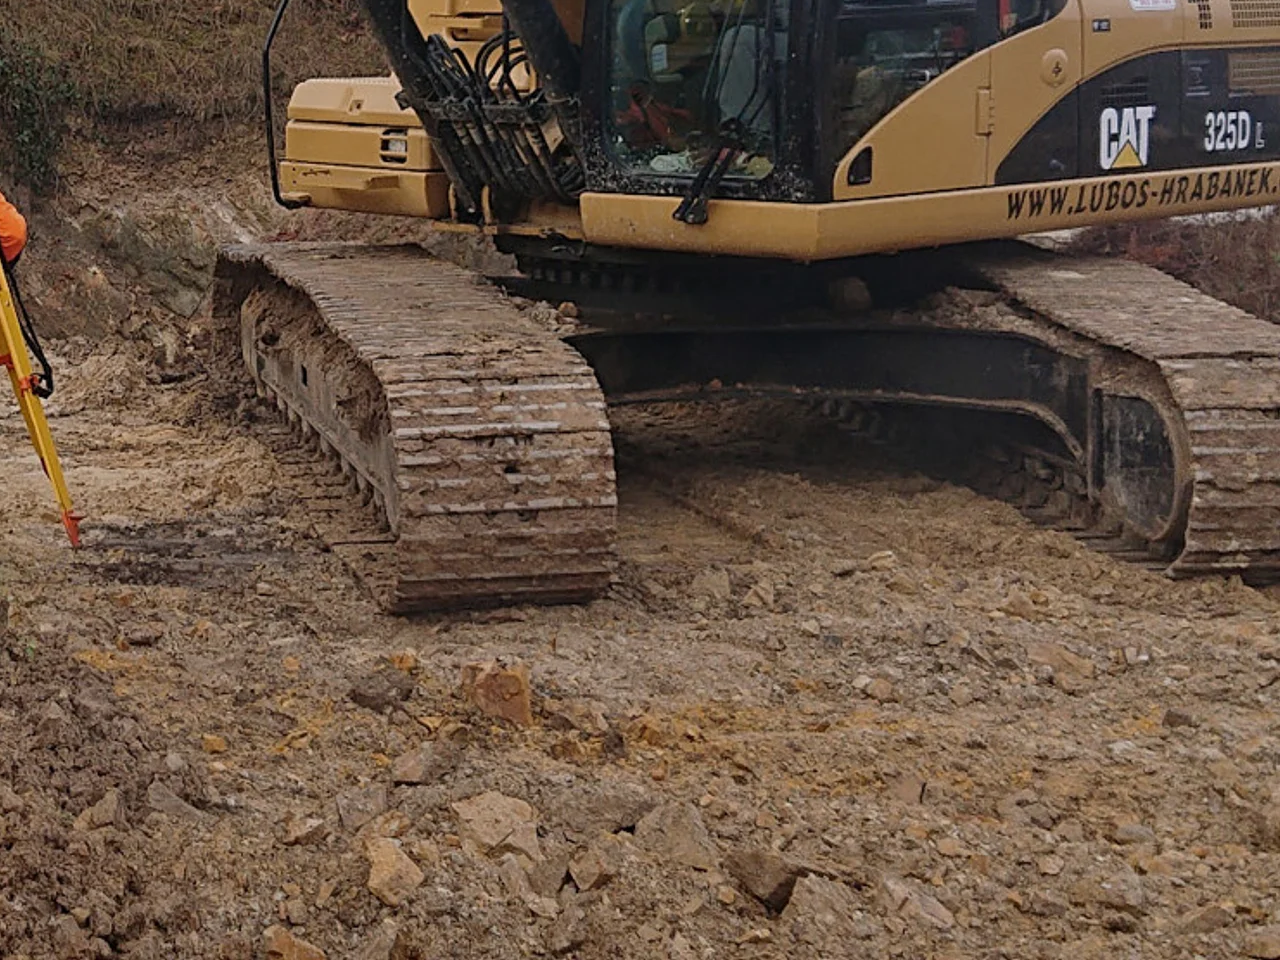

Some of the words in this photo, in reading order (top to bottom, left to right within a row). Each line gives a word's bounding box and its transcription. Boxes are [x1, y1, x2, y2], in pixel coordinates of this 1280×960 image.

[1099, 105, 1153, 170] CAT
[1204, 111, 1251, 152] 325D
[1007, 167, 1280, 220] WWW.LUBOS-HRABANEK.
